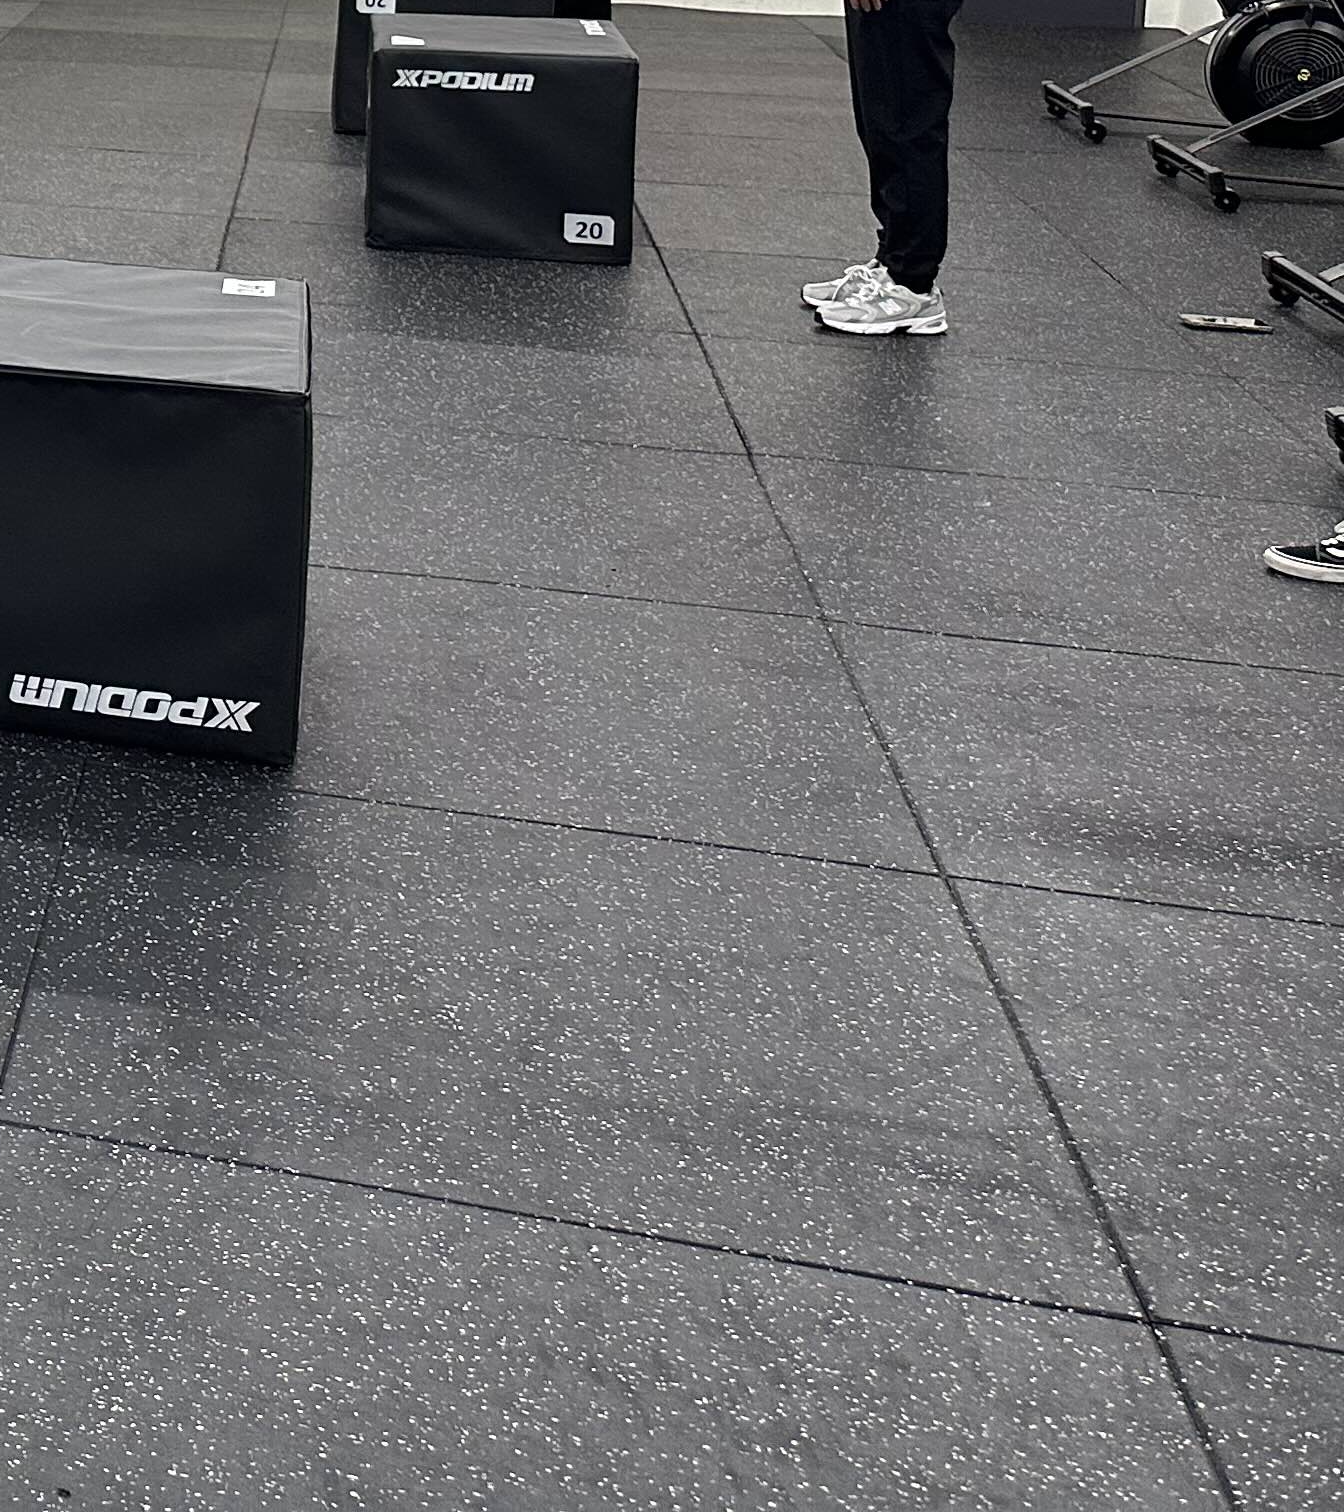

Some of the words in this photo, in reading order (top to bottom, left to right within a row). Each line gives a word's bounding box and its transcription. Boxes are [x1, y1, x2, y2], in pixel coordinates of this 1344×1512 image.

[392, 68, 535, 92] XPODIUM
[575, 221, 604, 240] 20
[9, 673, 261, 732] XPODIUM
